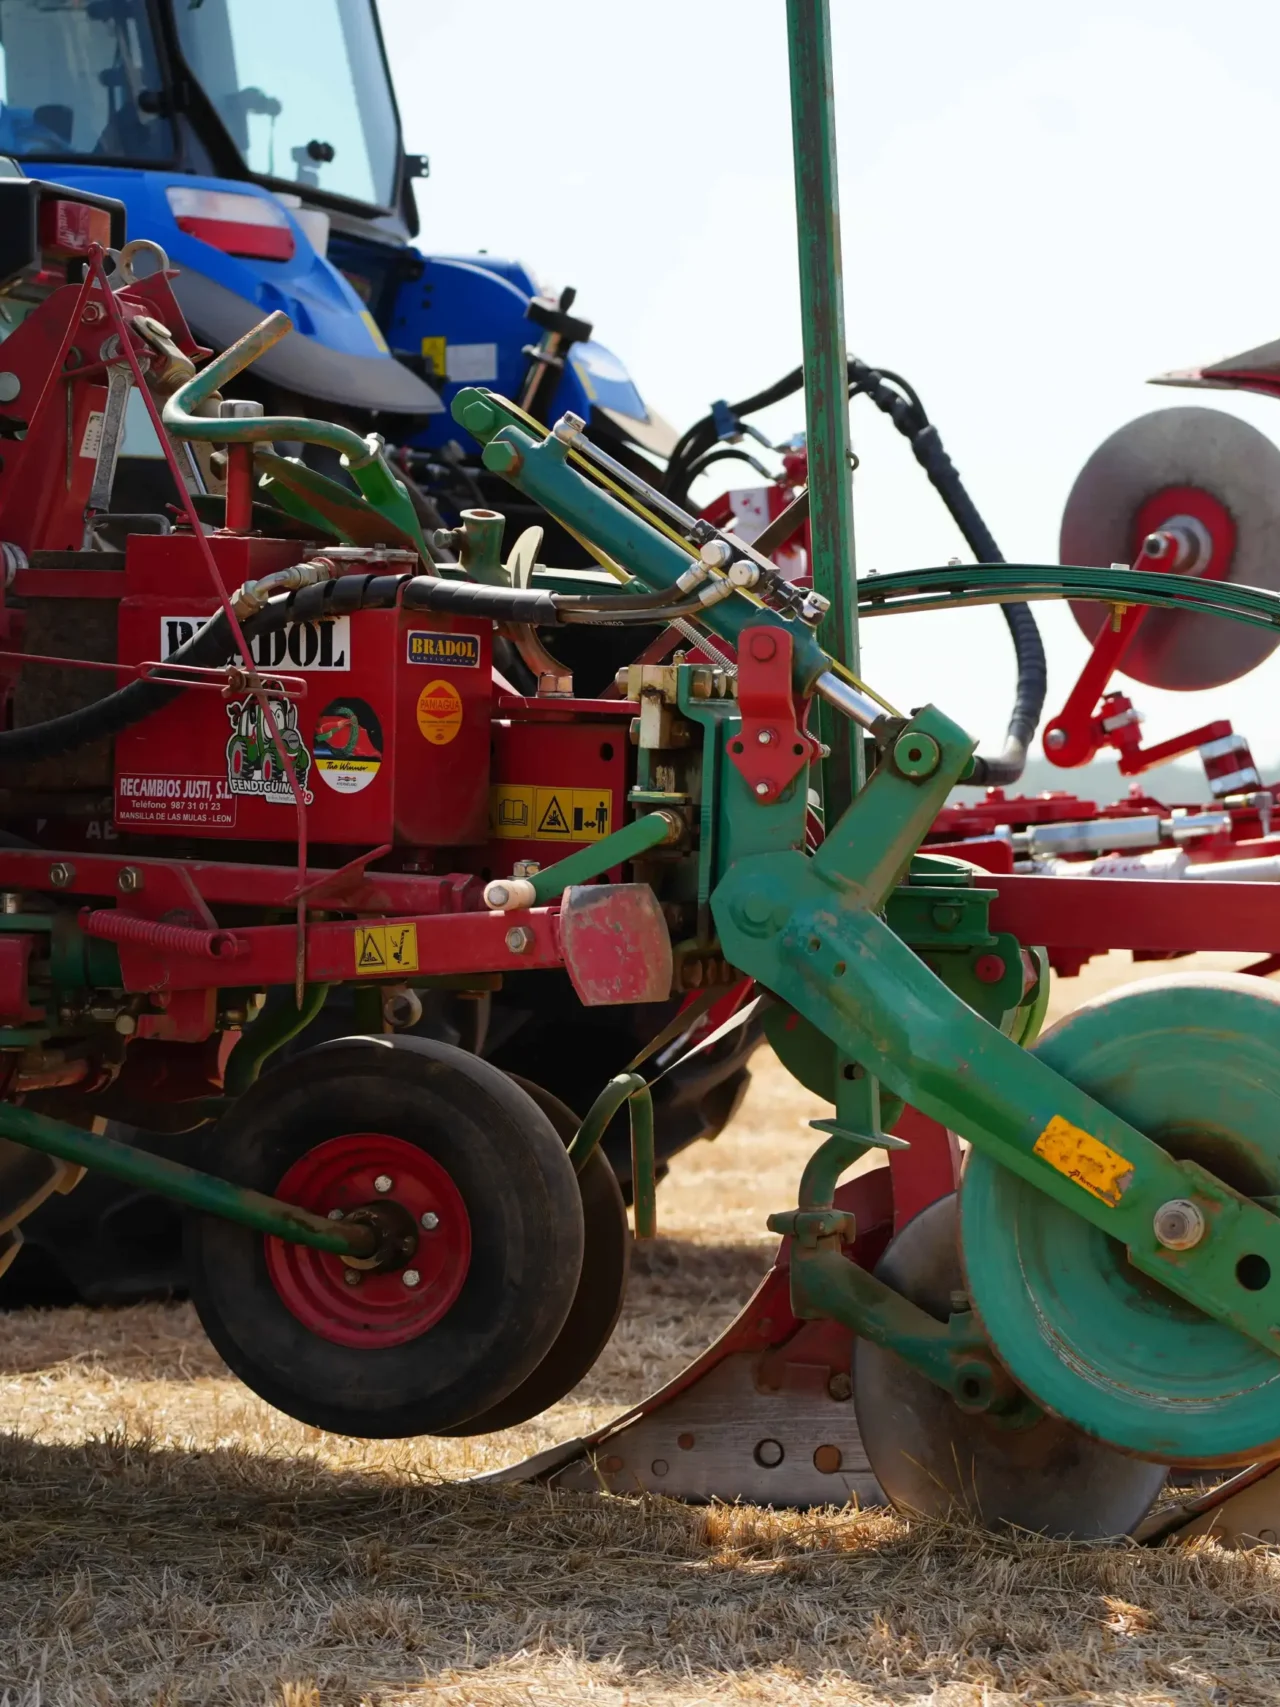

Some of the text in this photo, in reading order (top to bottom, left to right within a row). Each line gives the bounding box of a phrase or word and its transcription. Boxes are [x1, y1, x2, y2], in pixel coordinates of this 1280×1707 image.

[412, 638, 476, 657] BRADOL
[340, 762, 369, 771] Winner
[120, 779, 181, 798] RECAMBIOS
[184, 780, 213, 801] JUSTI,
[132, 800, 221, 811] Teléfono 987 31 01 23
[120, 812, 155, 820] MANSILLA
[167, 813, 182, 821] LAS
[183, 814, 207, 822] MULAS
[213, 815, 232, 823] LEON
